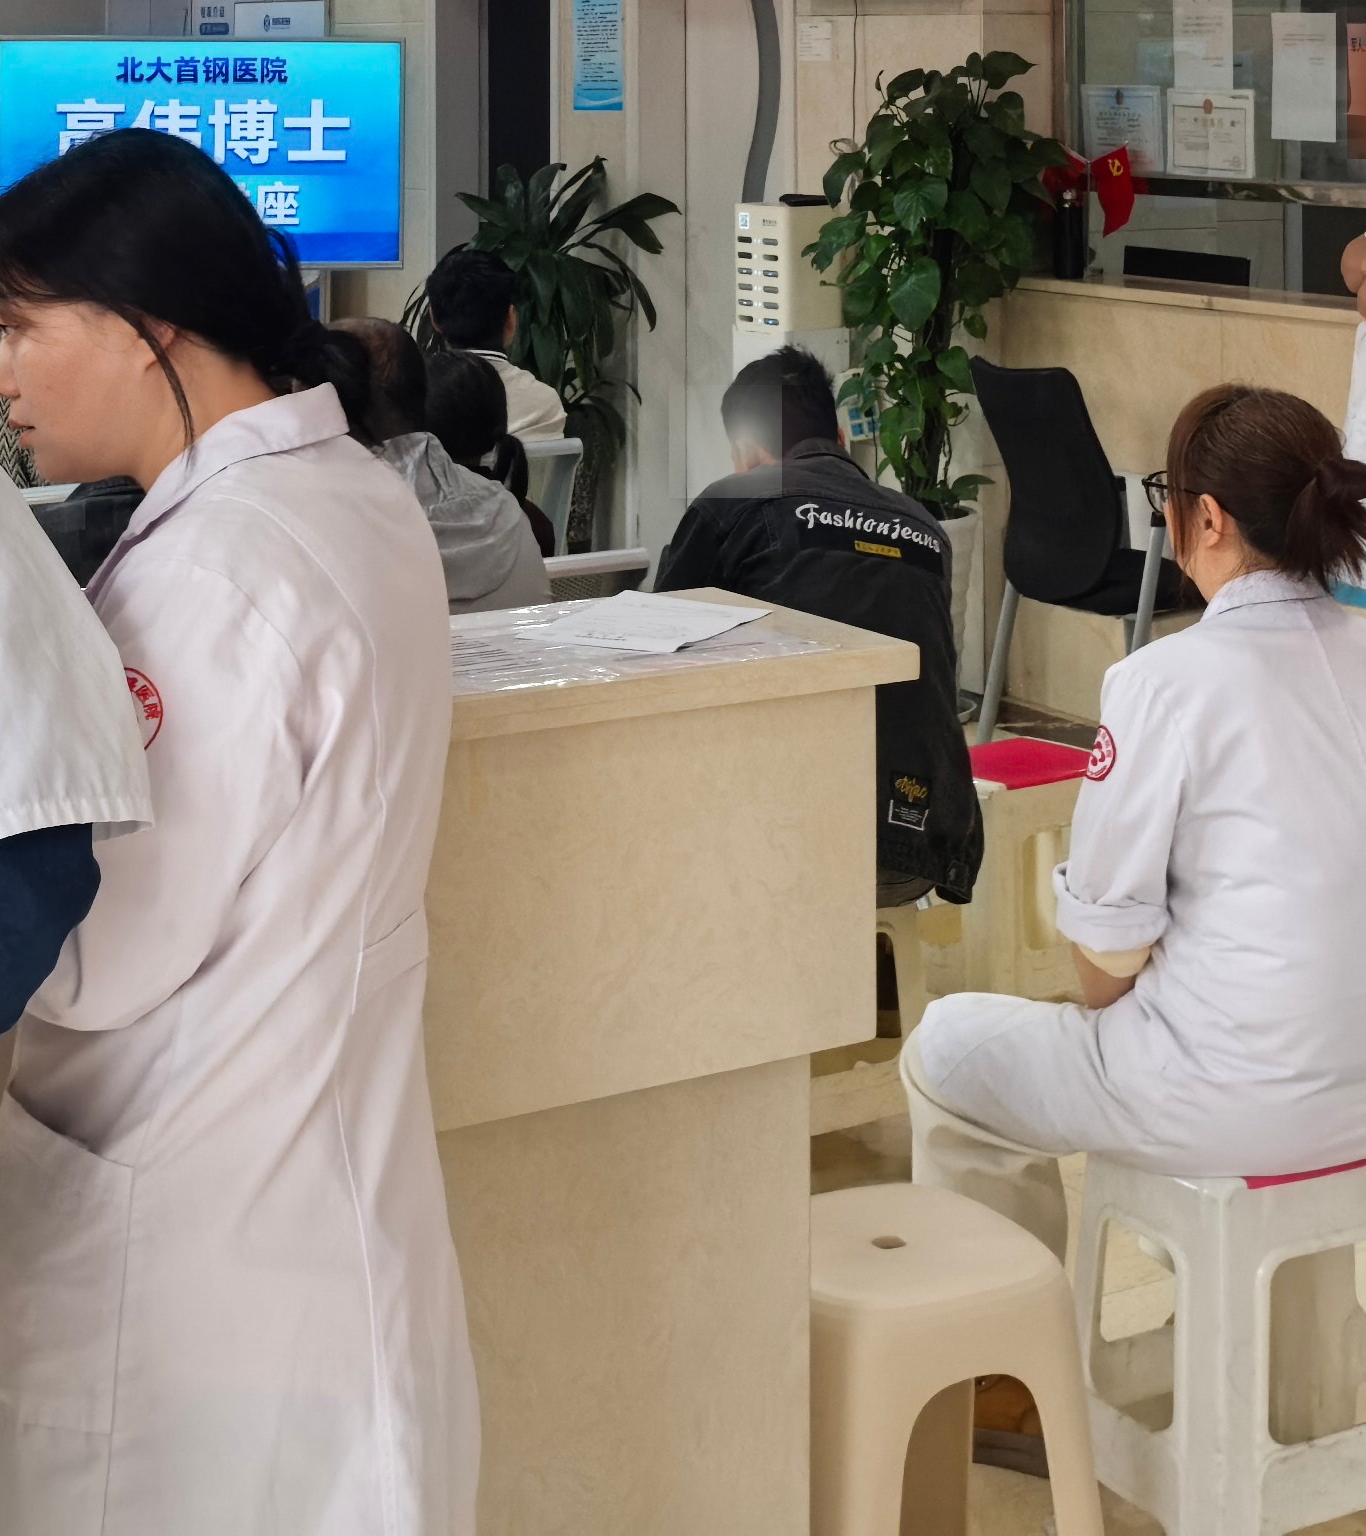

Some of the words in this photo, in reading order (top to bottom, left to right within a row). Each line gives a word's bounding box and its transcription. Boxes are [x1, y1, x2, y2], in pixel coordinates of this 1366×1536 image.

[116, 56, 288, 84] 北大首钢医院
